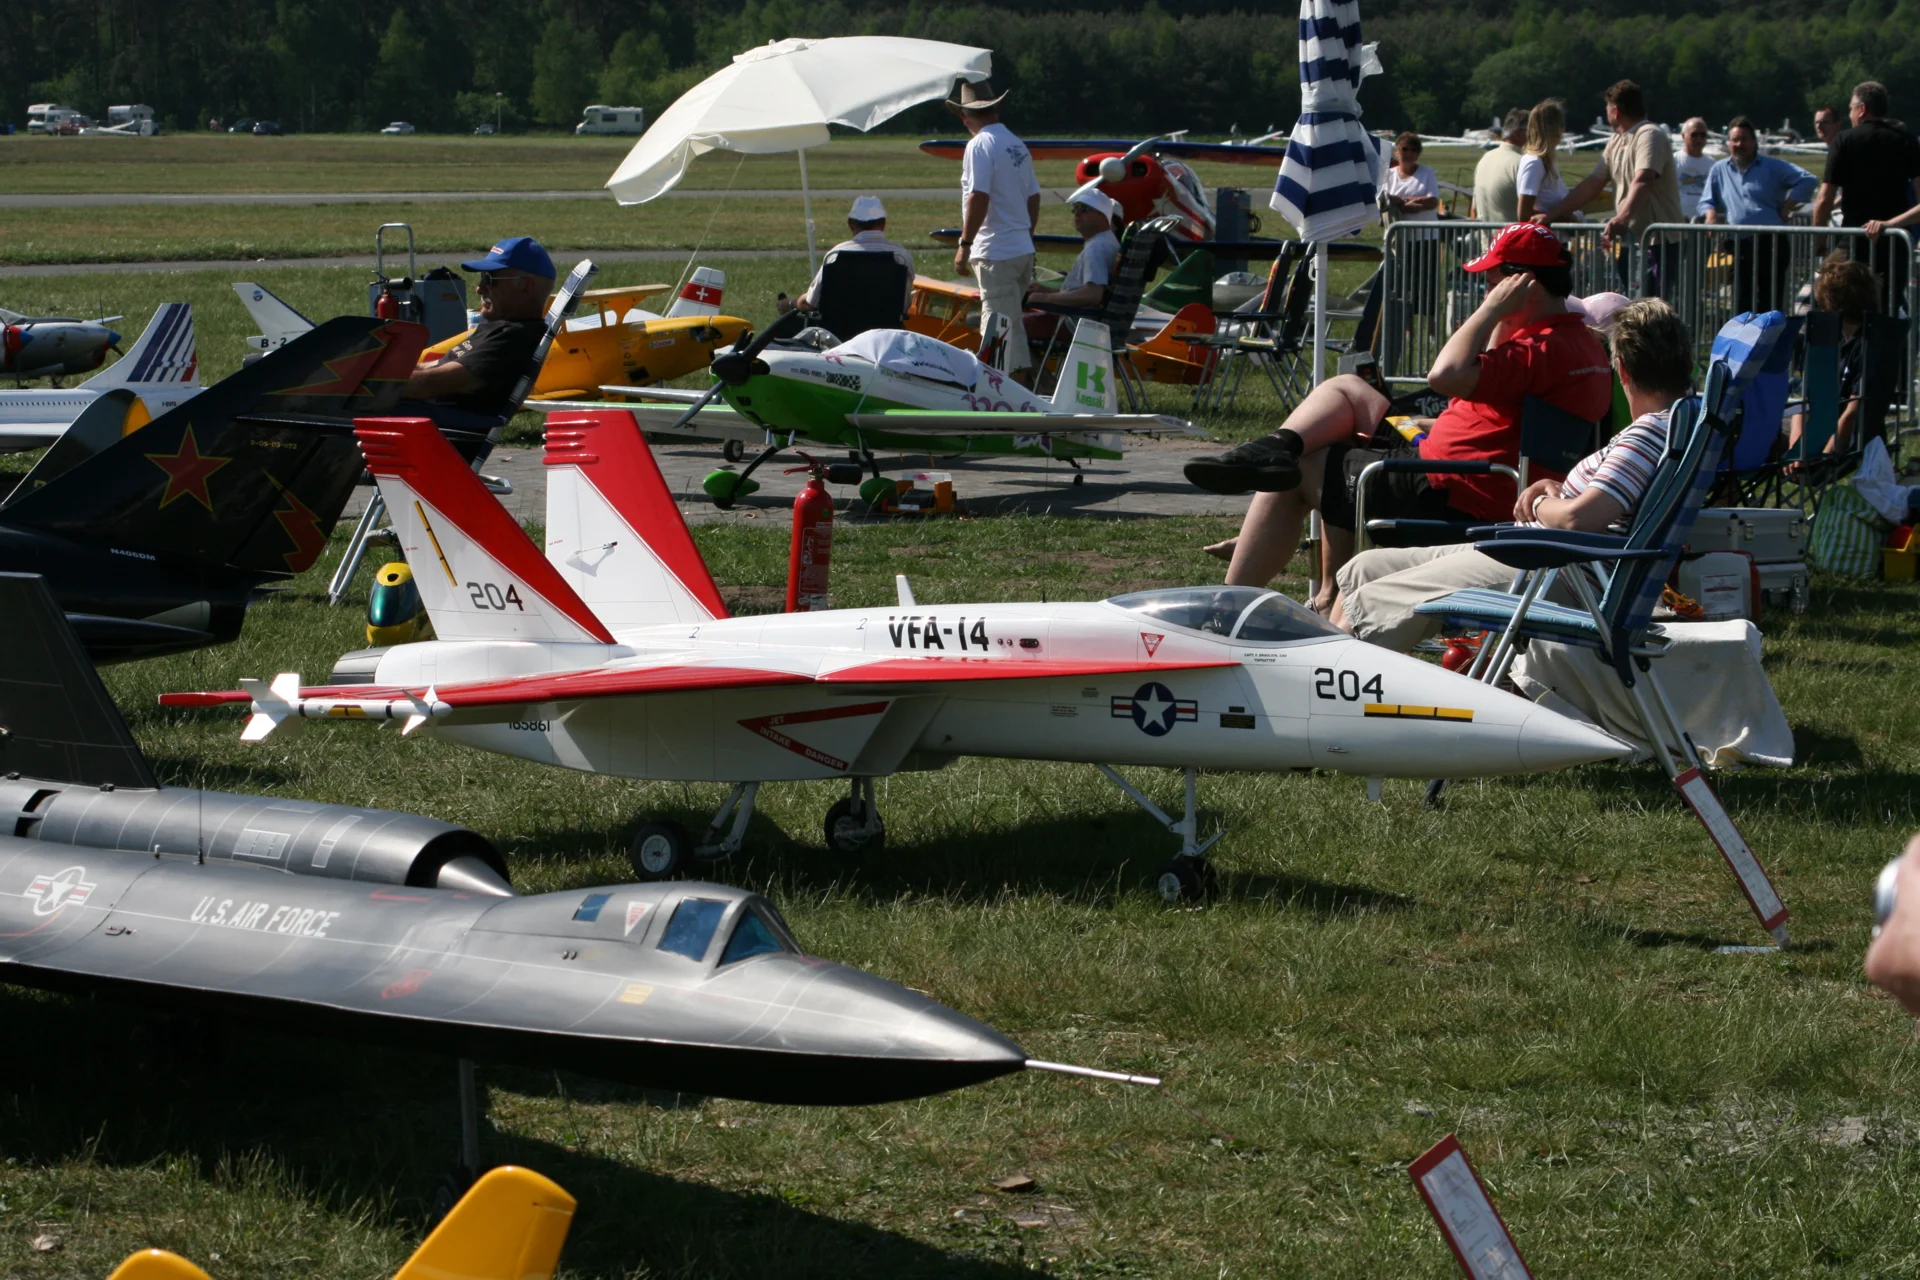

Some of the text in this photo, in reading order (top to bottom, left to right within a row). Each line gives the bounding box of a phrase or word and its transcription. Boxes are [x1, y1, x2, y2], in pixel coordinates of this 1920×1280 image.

[1414, 396, 1450, 417] Kös
[110, 548, 156, 561] N406DM
[467, 582, 524, 611] 204
[889, 616, 989, 651] VFA-14
[1314, 667, 1384, 703] 204
[769, 715, 785, 725] JET
[760, 726, 845, 769] INTAKE DANGER
[228, 901, 270, 929] AIR
[264, 905, 341, 938] FORCE
